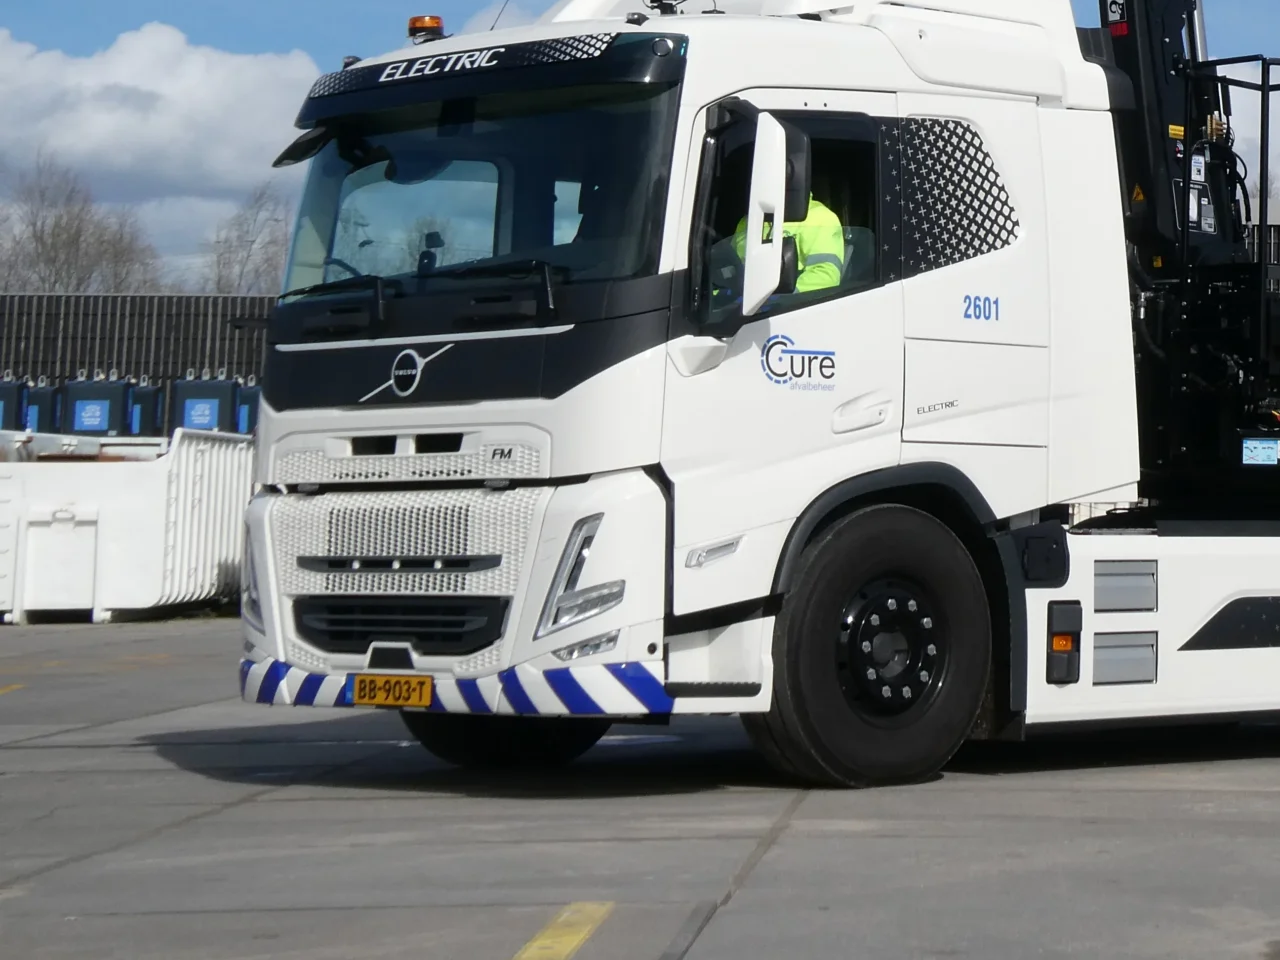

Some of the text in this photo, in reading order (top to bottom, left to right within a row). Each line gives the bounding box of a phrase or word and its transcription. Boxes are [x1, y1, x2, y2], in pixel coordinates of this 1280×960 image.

[379, 48, 506, 82] ELECTRIC
[963, 294, 999, 321] 2601
[764, 339, 836, 380] Cure
[789, 381, 836, 391] afvalbeheer
[916, 400, 959, 415] ELECTRIC
[491, 448, 513, 460] FM
[358, 678, 426, 703] BB-903-T
